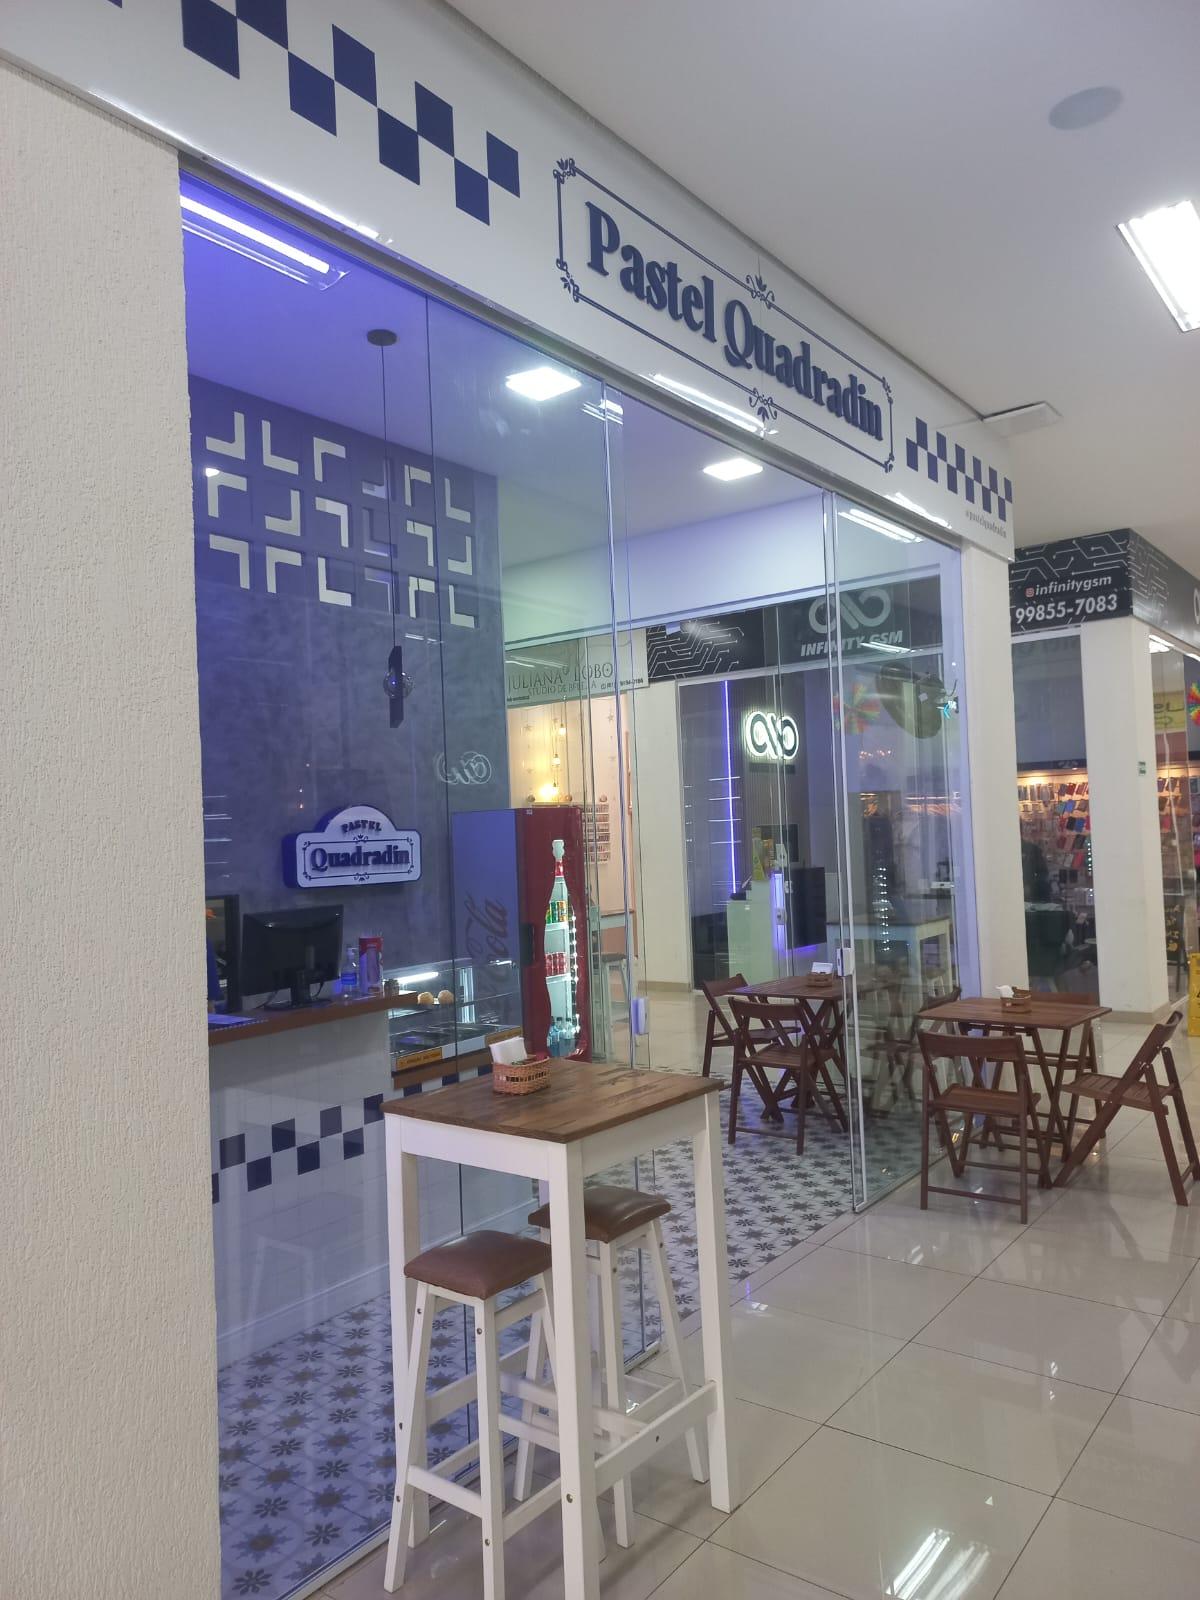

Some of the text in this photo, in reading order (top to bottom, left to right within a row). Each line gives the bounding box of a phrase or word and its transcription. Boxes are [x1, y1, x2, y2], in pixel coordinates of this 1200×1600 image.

[585, 201, 884, 441] Pastel Quadradin
[1015, 594, 1117, 624] 99855-7083
[310, 845, 410, 872] Quadradin
